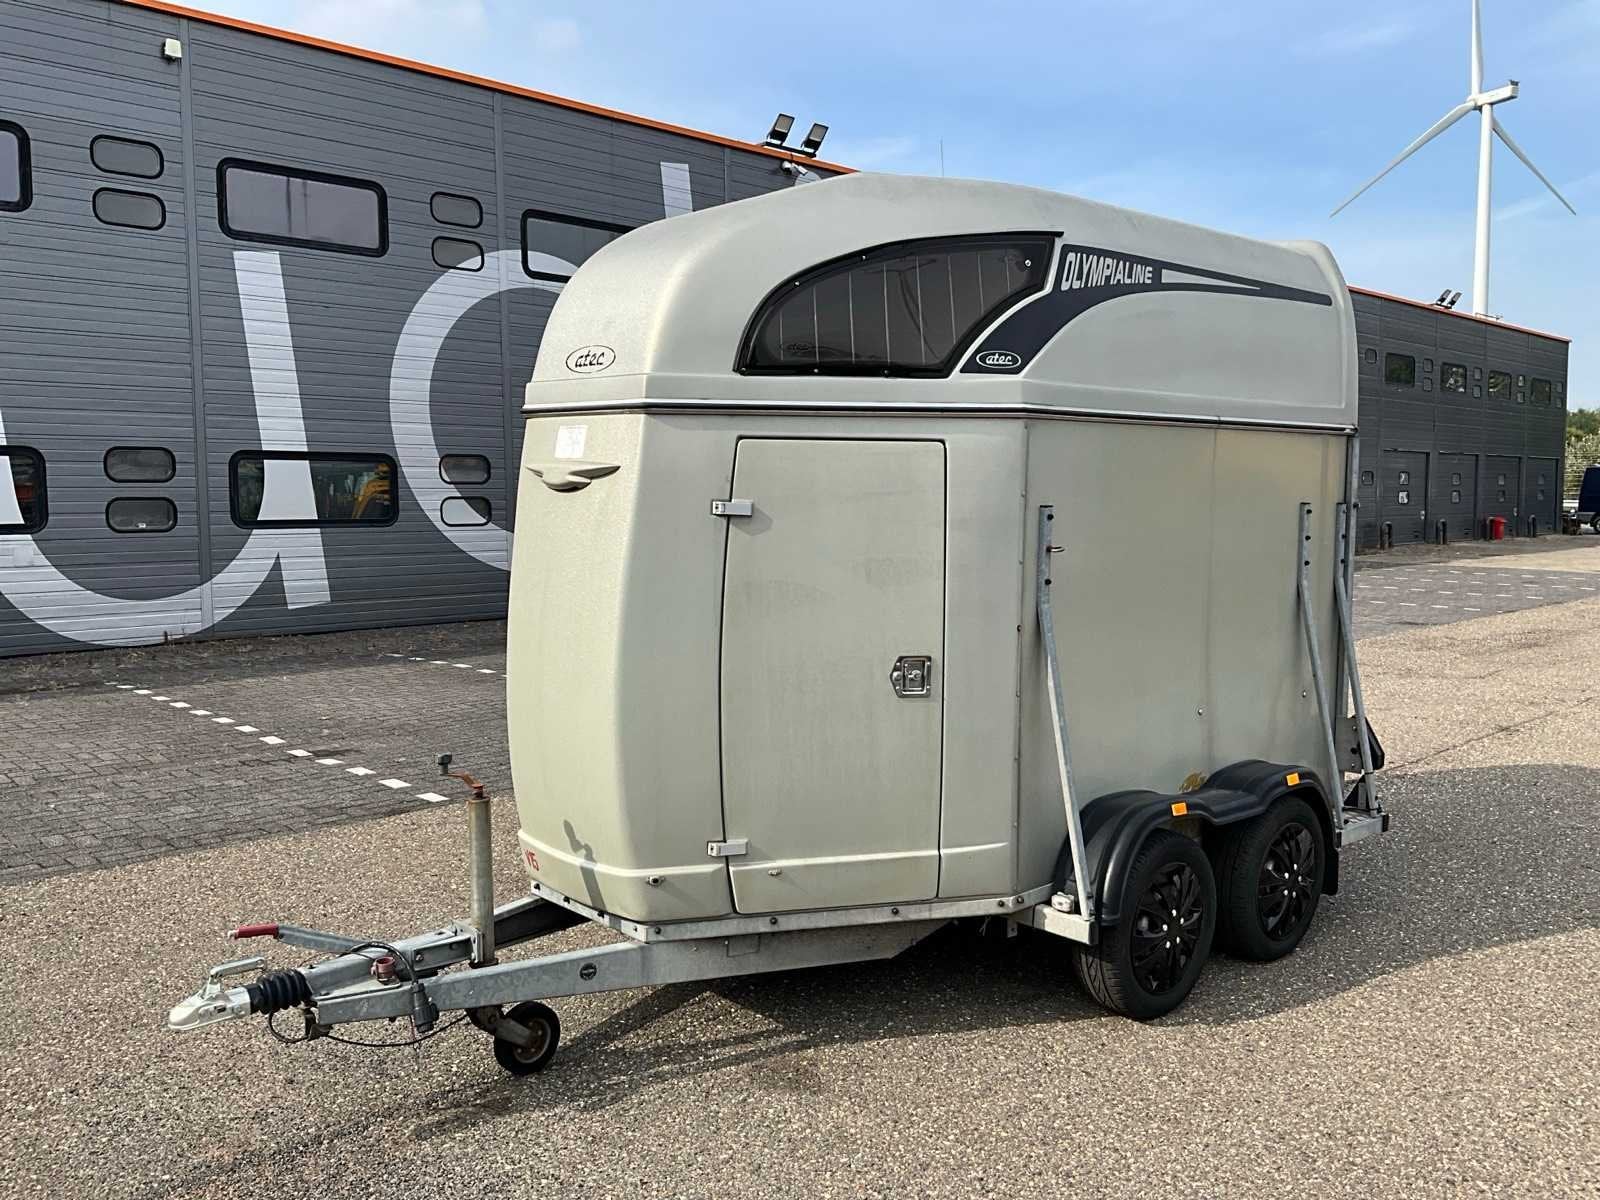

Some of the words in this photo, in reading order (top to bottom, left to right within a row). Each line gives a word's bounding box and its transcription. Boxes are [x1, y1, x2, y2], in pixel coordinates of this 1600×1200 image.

[1060, 251, 1153, 292] OLYMPIALINE
[575, 350, 605, 368] atec
[985, 353, 1013, 365] atec
